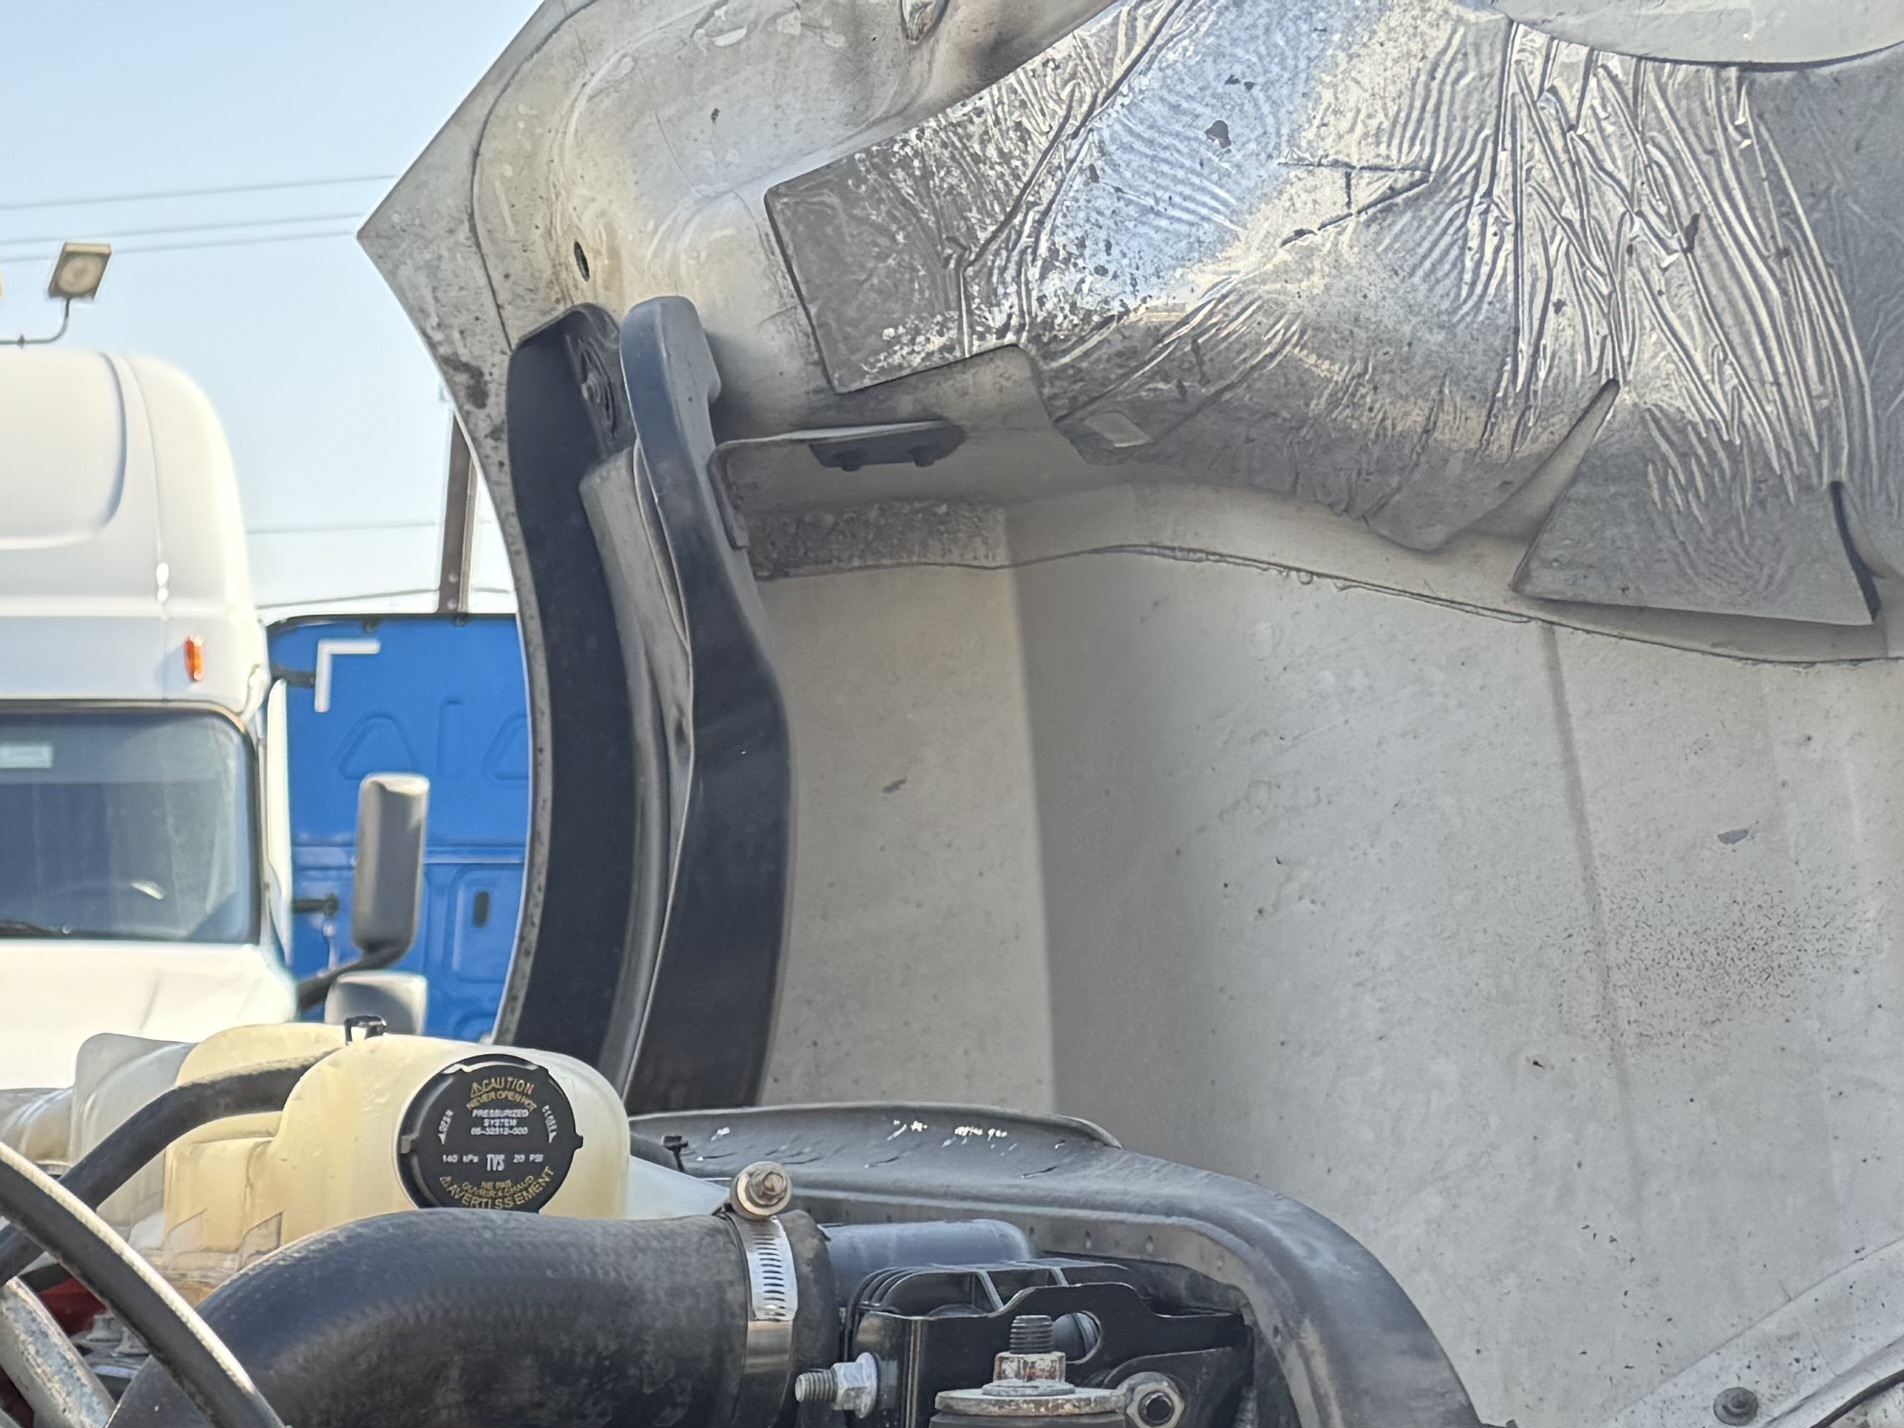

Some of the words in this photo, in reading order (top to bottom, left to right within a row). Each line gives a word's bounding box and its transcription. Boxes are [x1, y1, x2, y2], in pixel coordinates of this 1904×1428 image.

[481, 1077, 534, 1094] CAUTION
[472, 1108, 529, 1118] PRESSURIZED
[486, 1153, 505, 1171] TVS
[513, 1154, 525, 1163] 20
[446, 1165, 554, 1210] AVERTISSEMENT
